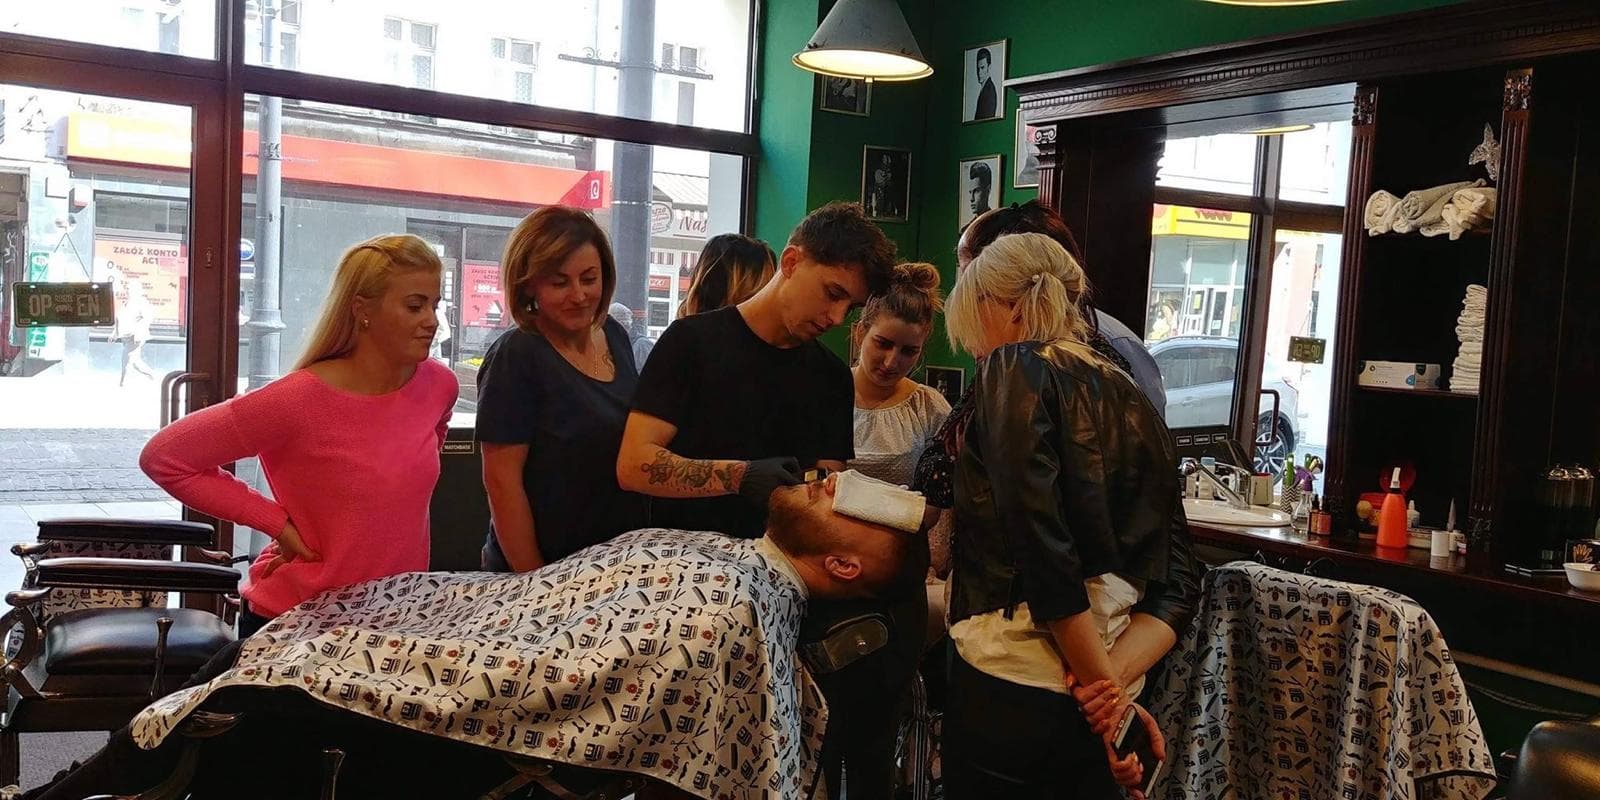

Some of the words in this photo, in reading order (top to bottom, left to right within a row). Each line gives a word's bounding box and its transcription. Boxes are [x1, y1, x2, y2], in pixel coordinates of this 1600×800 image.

[147, 248, 178, 257] KONTO
[28, 294, 52, 316] OP
[76, 294, 100, 316] EN
